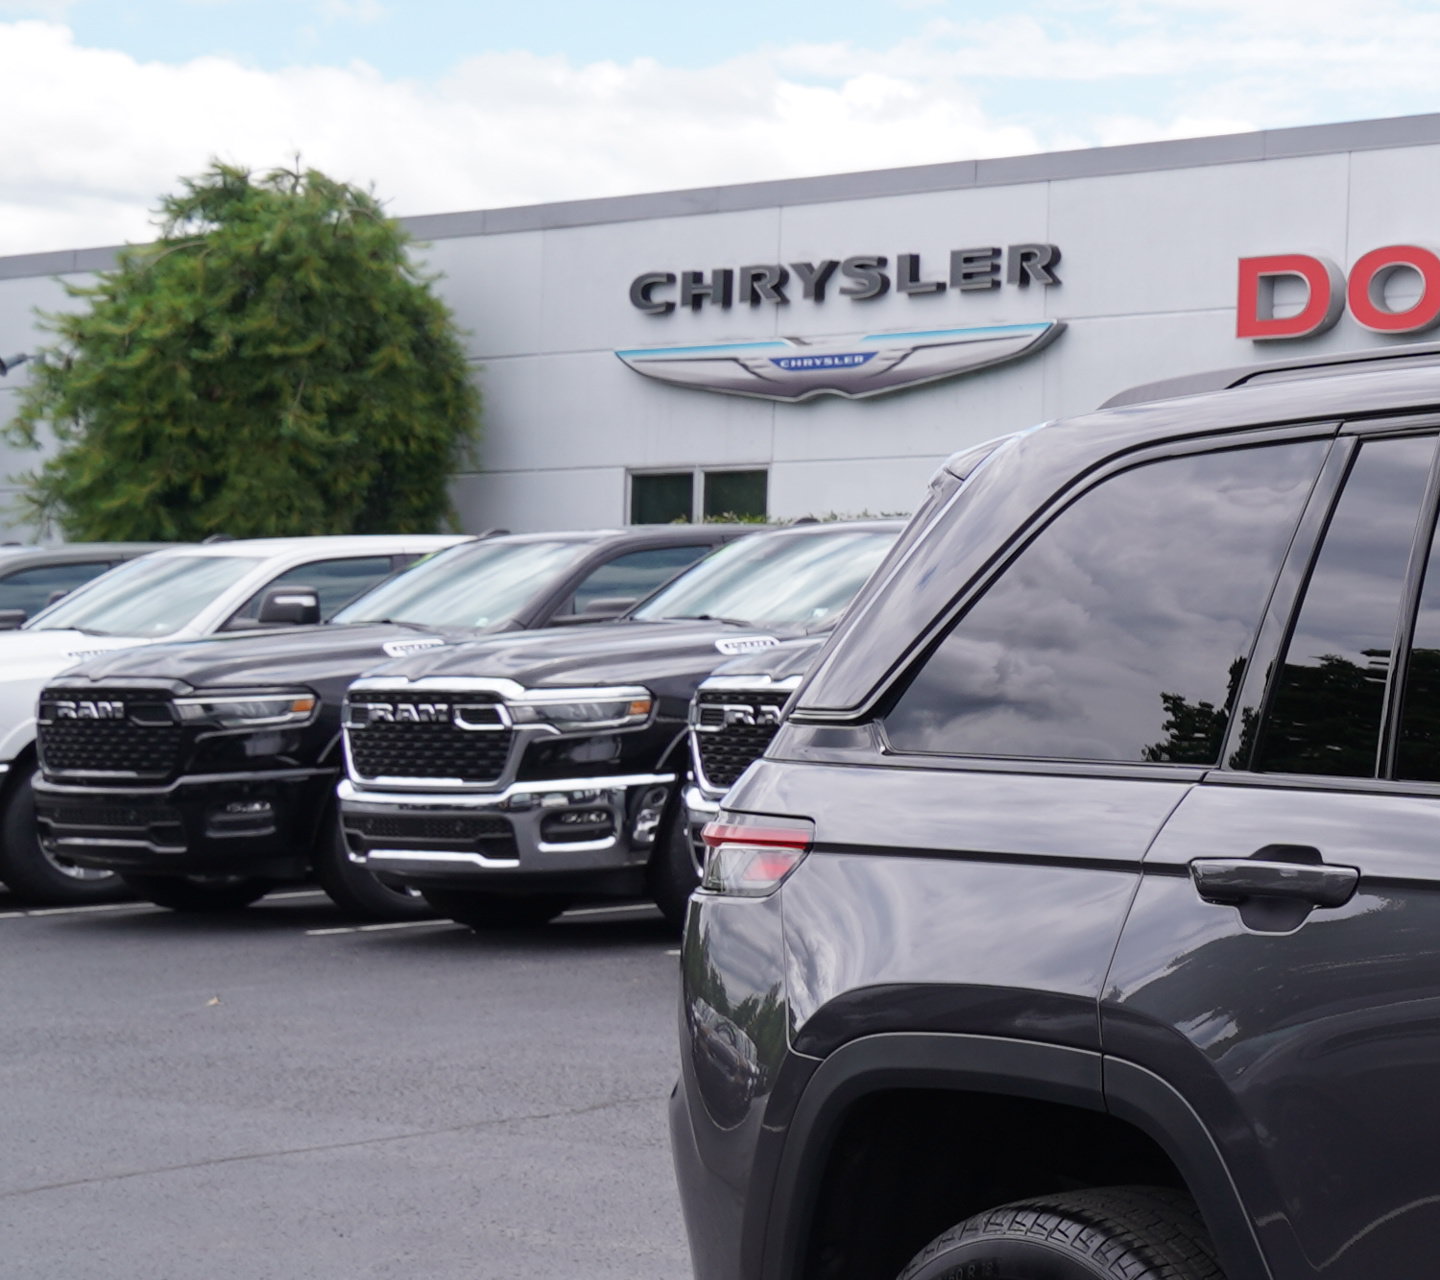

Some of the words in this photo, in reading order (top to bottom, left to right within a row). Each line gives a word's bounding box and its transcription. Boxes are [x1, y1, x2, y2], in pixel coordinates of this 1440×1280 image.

[629, 244, 1063, 315] CHRYSLER
[780, 355, 864, 368] CHRYSLER
[56, 701, 124, 719] RAM
[367, 704, 448, 722] RAM
